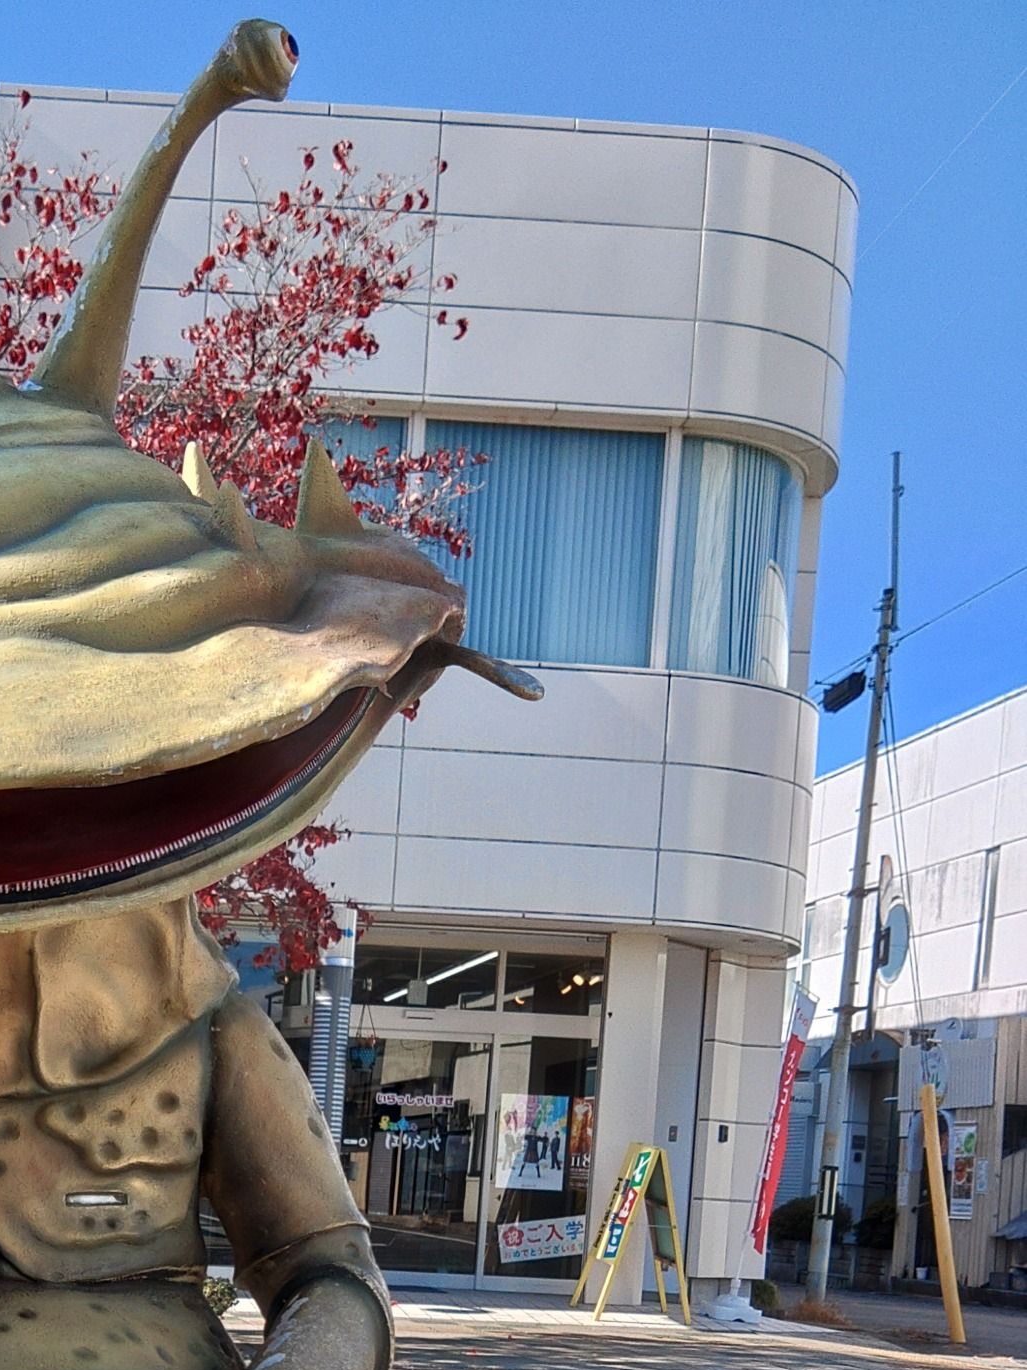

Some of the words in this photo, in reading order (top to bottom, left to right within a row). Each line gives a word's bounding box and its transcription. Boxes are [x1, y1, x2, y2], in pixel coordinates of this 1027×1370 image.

[376, 1092, 454, 1107] いらっしゃいませ
[527, 1221, 584, 1243] ご入学
